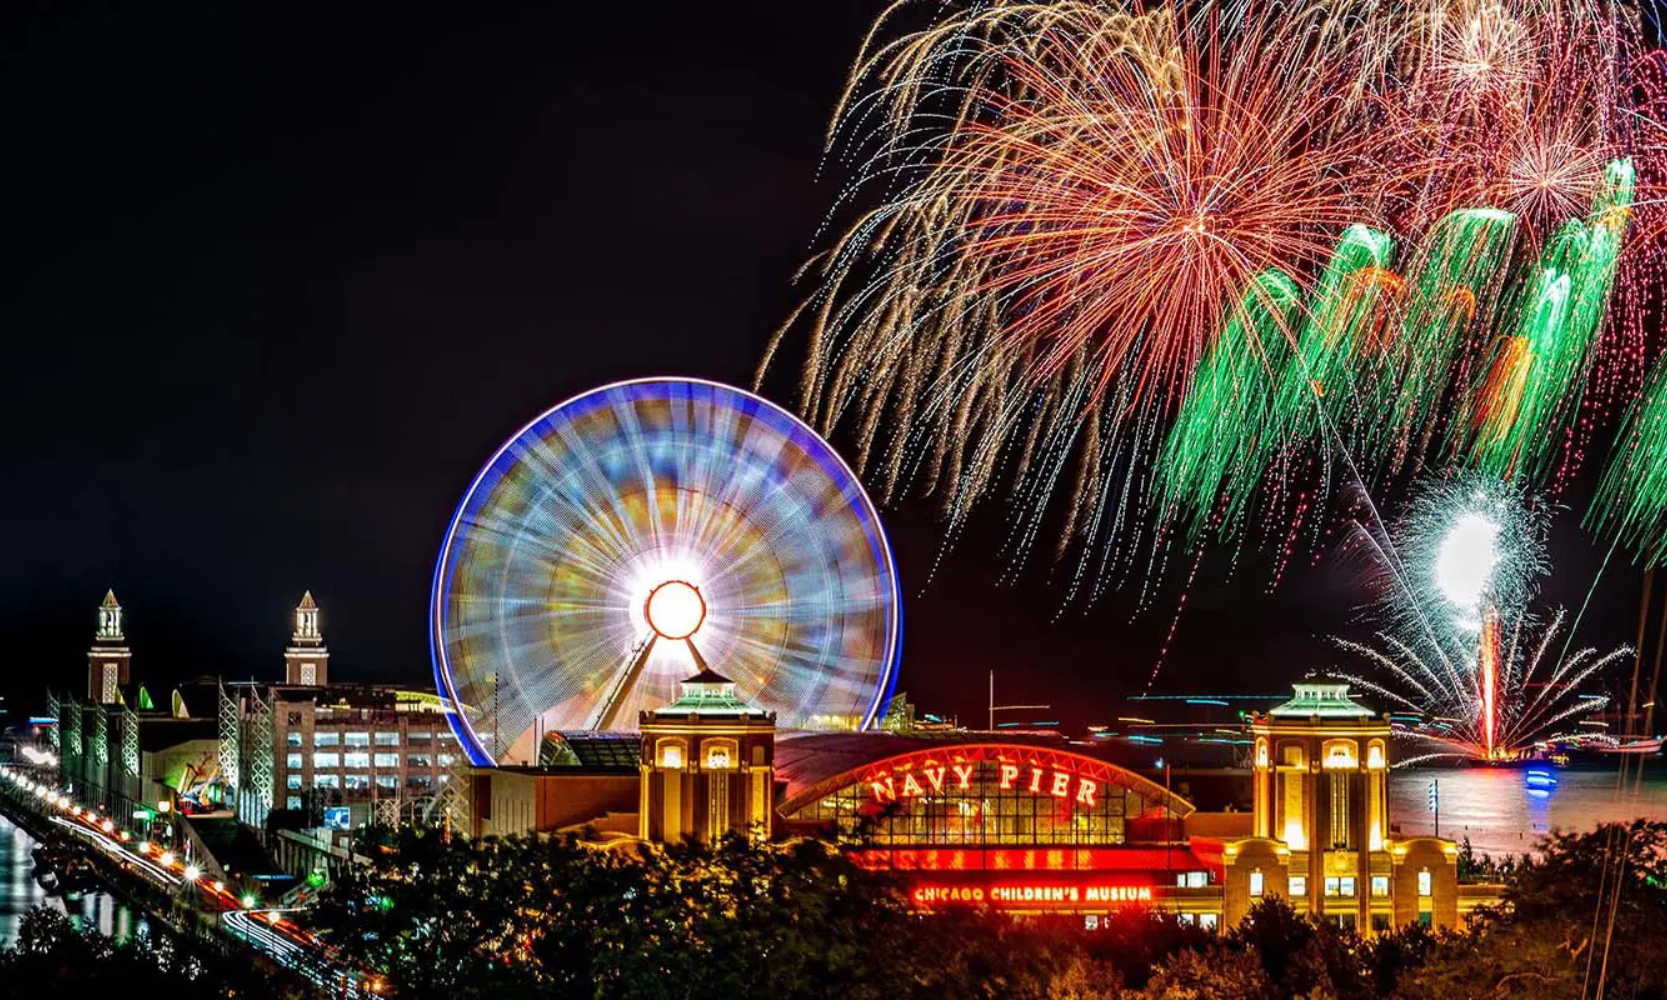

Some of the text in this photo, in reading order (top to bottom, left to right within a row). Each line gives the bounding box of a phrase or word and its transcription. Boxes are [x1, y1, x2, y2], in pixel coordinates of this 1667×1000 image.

[871, 764, 1097, 805] NAVY PIER
[914, 887, 1151, 901] CHICAGO CHILDREN'S MUSEUM
